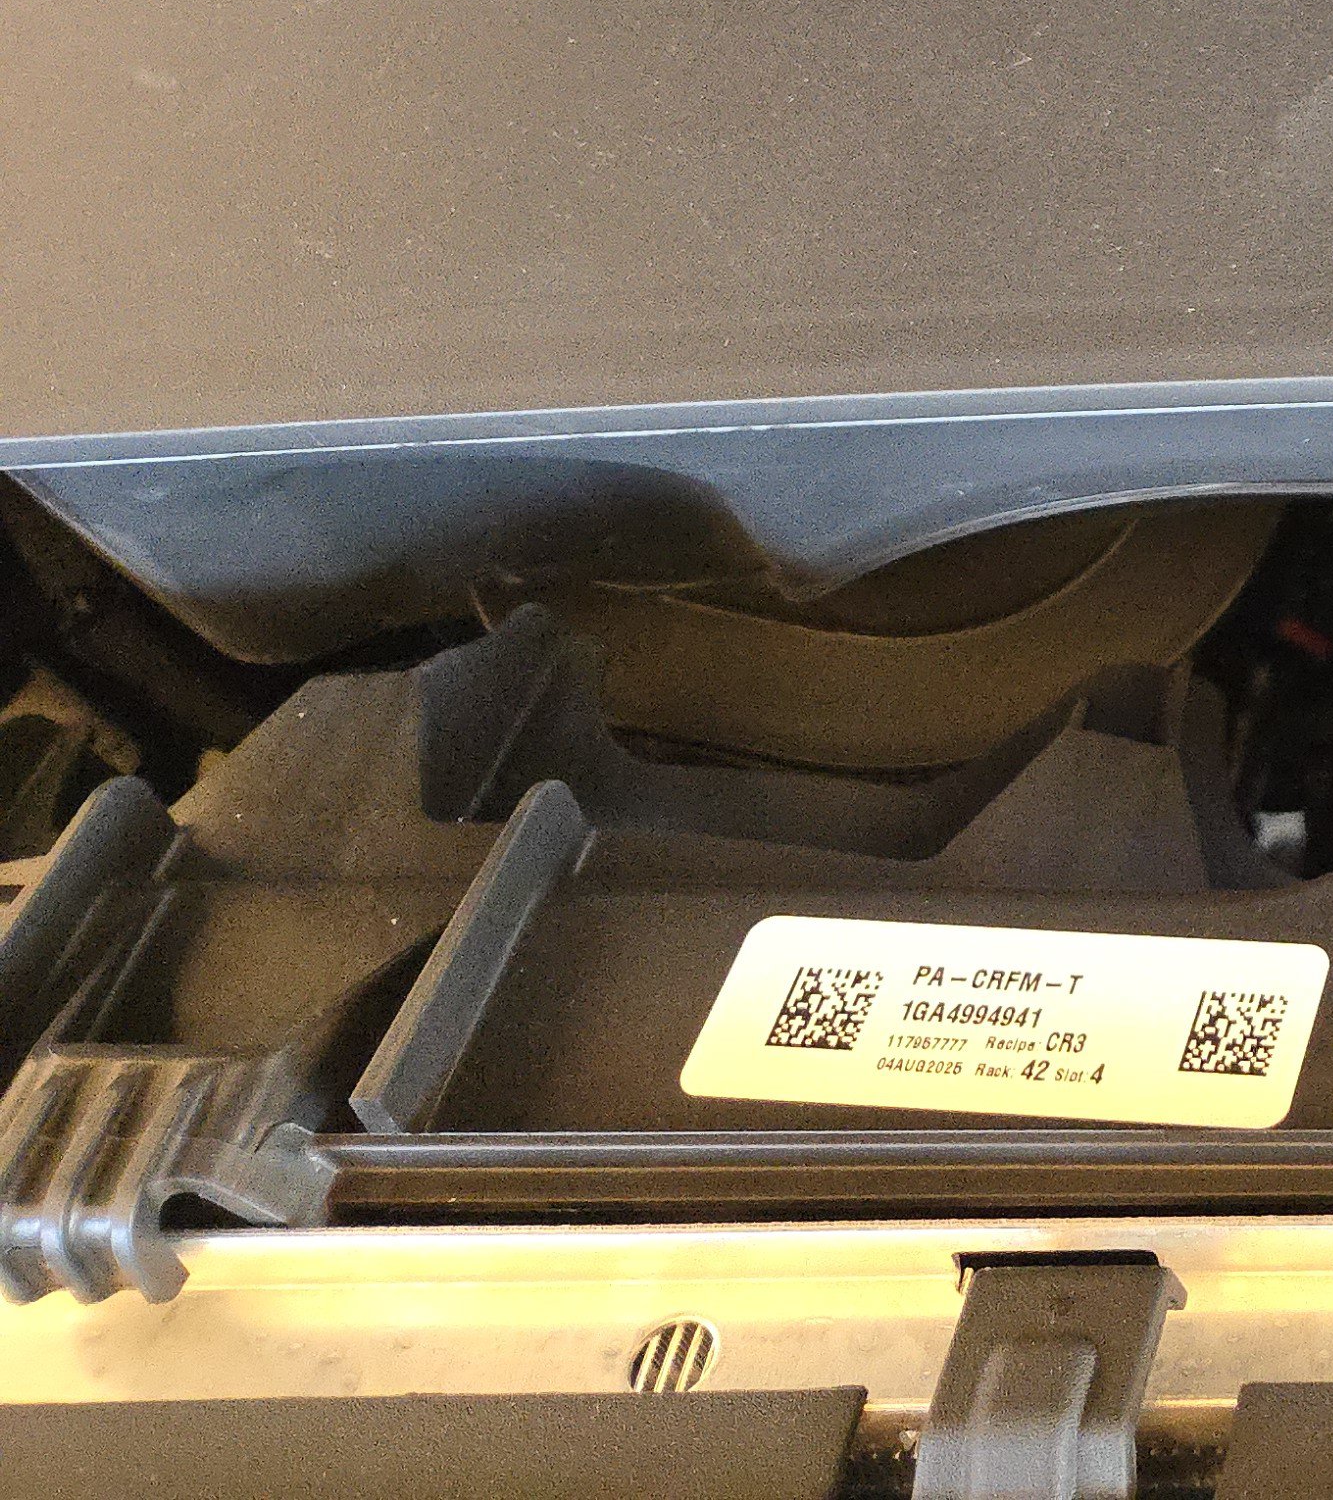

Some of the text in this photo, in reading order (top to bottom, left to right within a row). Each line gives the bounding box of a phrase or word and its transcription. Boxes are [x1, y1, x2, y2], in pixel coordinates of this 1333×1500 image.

[902, 1000, 1043, 1029] 1GA4994941
[1046, 1031, 1088, 1054] CR3
[1021, 1059, 1051, 1082] 42
[1090, 1063, 1106, 1085] 4
